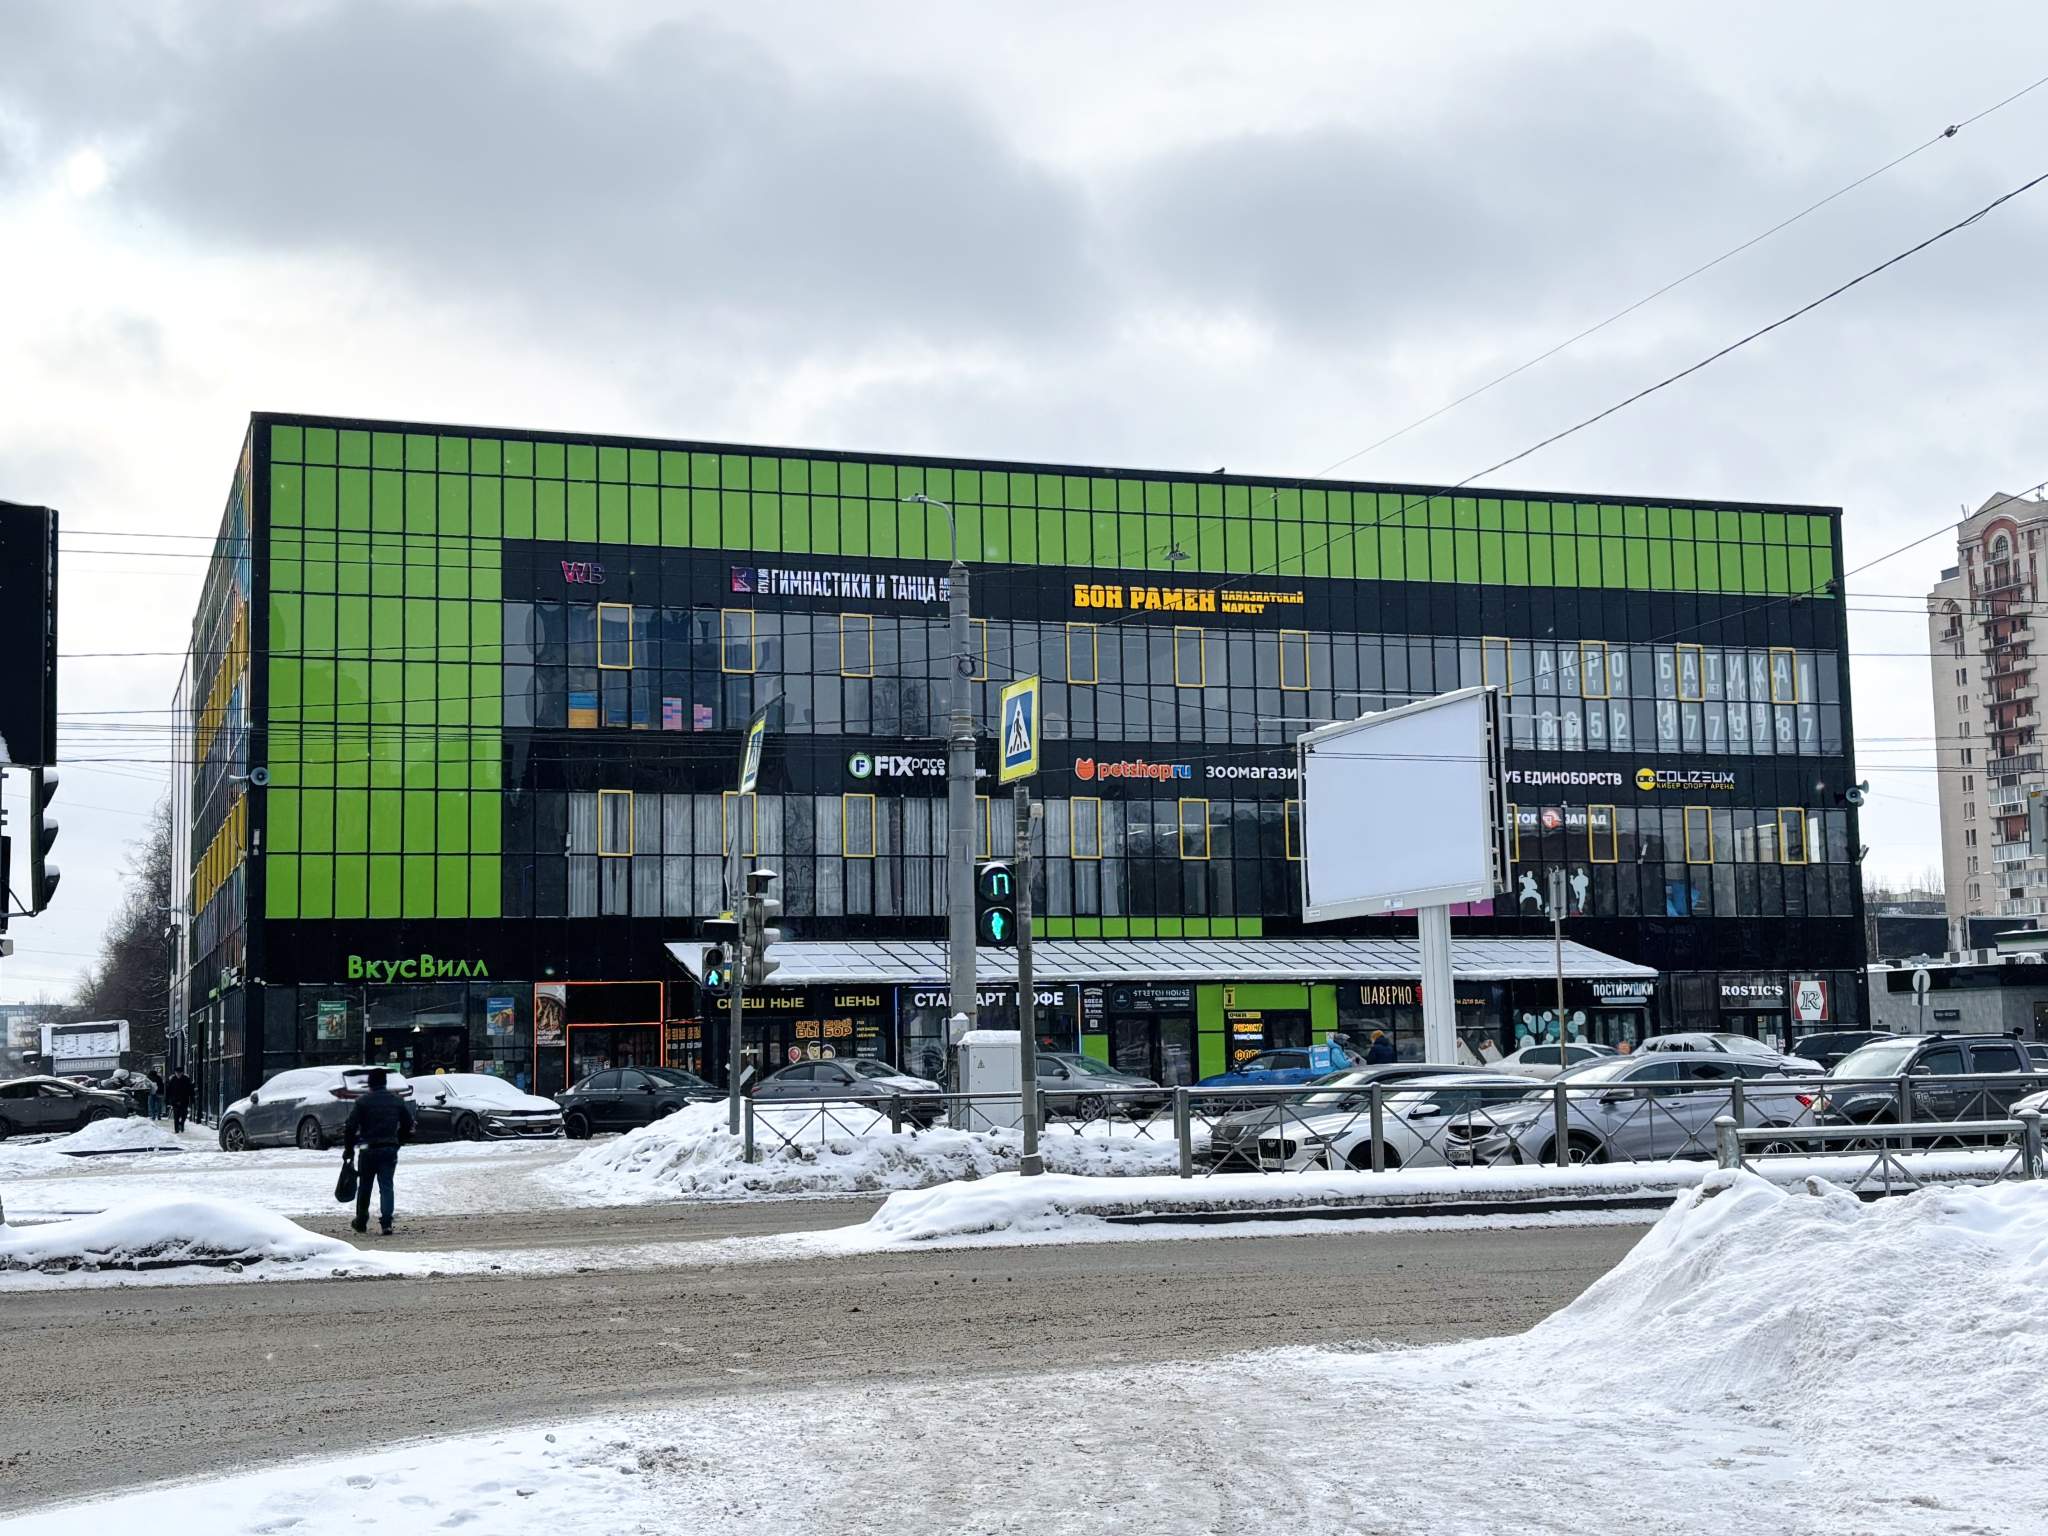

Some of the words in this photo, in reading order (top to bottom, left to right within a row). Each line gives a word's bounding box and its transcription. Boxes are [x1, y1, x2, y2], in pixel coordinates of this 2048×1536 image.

[561, 561, 606, 584] WB
[771, 569, 870, 598] ГИМНАСТИКИ
[876, 575, 885, 599] И
[890, 575, 937, 603] ТАНЦА
[1074, 584, 1123, 609] БОН
[1129, 589, 1216, 612] РАМЕН
[1221, 602, 1264, 614] МАРКЕТ
[874, 756, 914, 776] FIX
[912, 758, 946, 772] price
[1505, 771, 1521, 784] УБ
[1524, 772, 1623, 785] ЕДИНОБОРСТВ
[1656, 782, 1681, 790] КИБЕР
[1683, 782, 1707, 790] СПОРТ
[1711, 783, 1735, 791] АРЕНА
[1505, 814, 1538, 825] СТОК
[348, 953, 490, 984] ВкусВилл
[1593, 982, 1654, 997] ПОСТИРУШКИ
[1721, 985, 1784, 996] ROSTIC'S
[834, 995, 880, 1008] ЦЕНЫ
[914, 992, 1007, 1007] СТААРТ
[1015, 991, 1064, 1006] ФЕ
